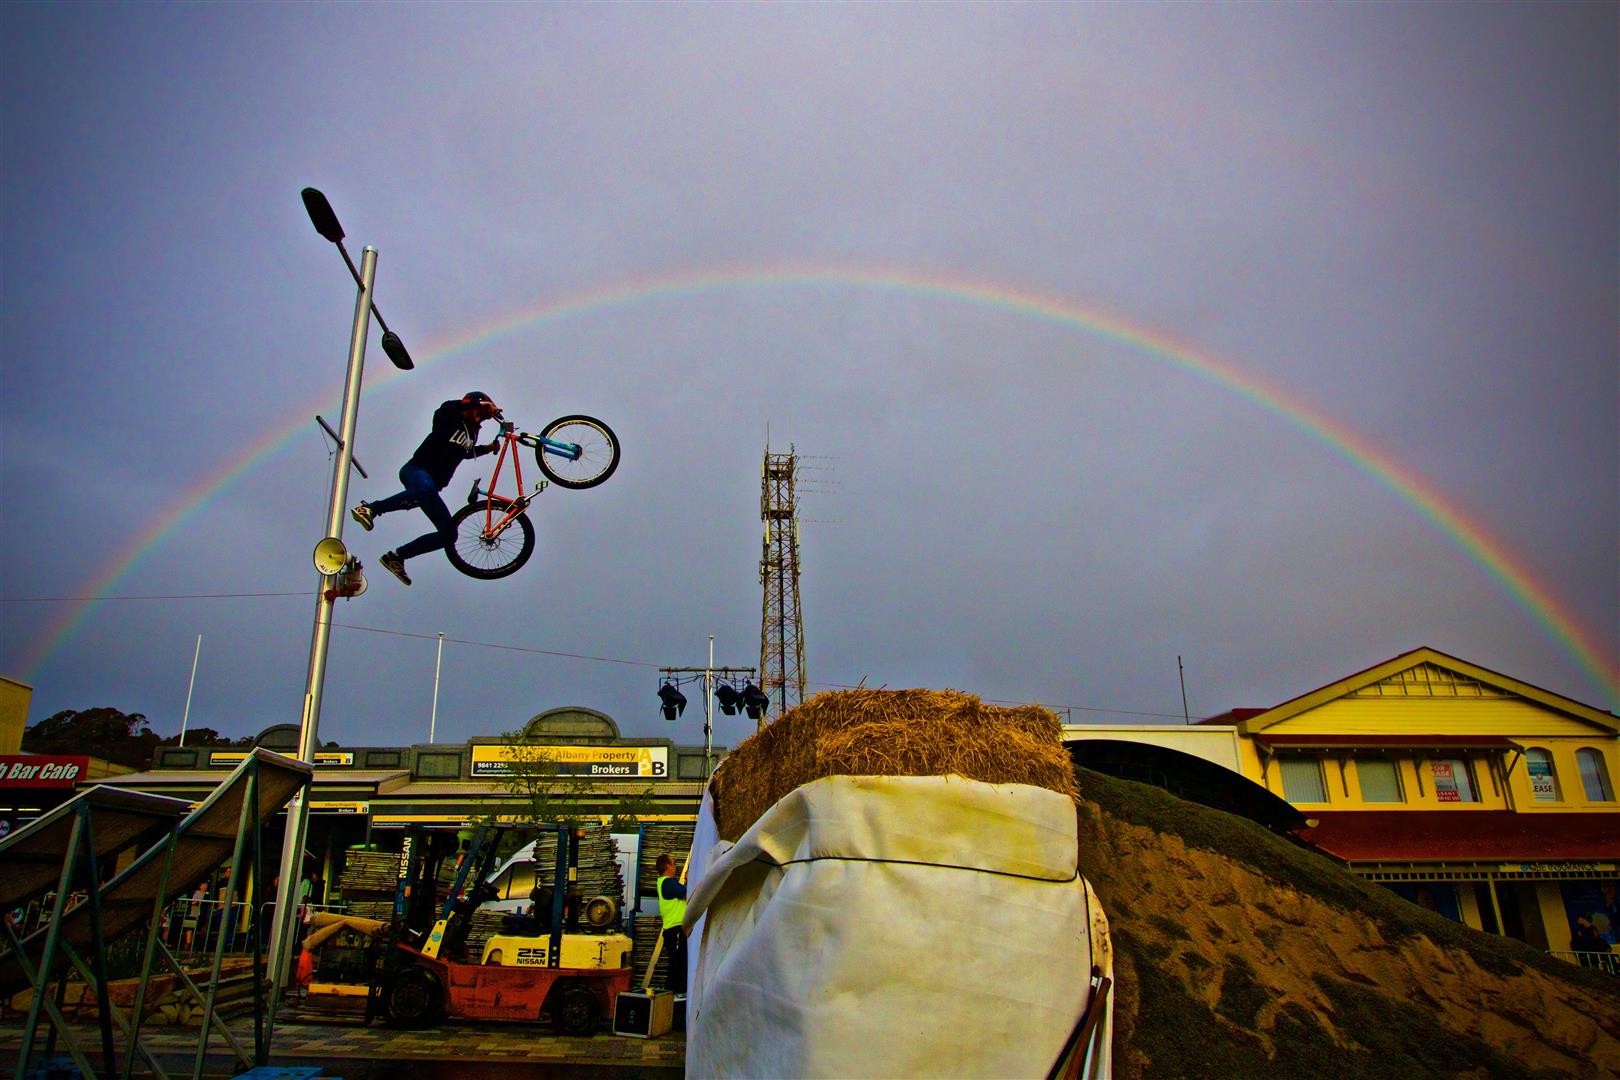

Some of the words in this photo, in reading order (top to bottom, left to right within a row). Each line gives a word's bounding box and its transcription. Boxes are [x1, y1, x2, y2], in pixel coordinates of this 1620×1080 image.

[555, 751, 589, 760] Albany
[593, 751, 635, 761] Property
[7, 763, 41, 779] Bar
[40, 763, 80, 779] Cafe
[591, 764, 630, 774] Brokers
[399, 837, 412, 878] NISSAN
[518, 948, 546, 958] 25
